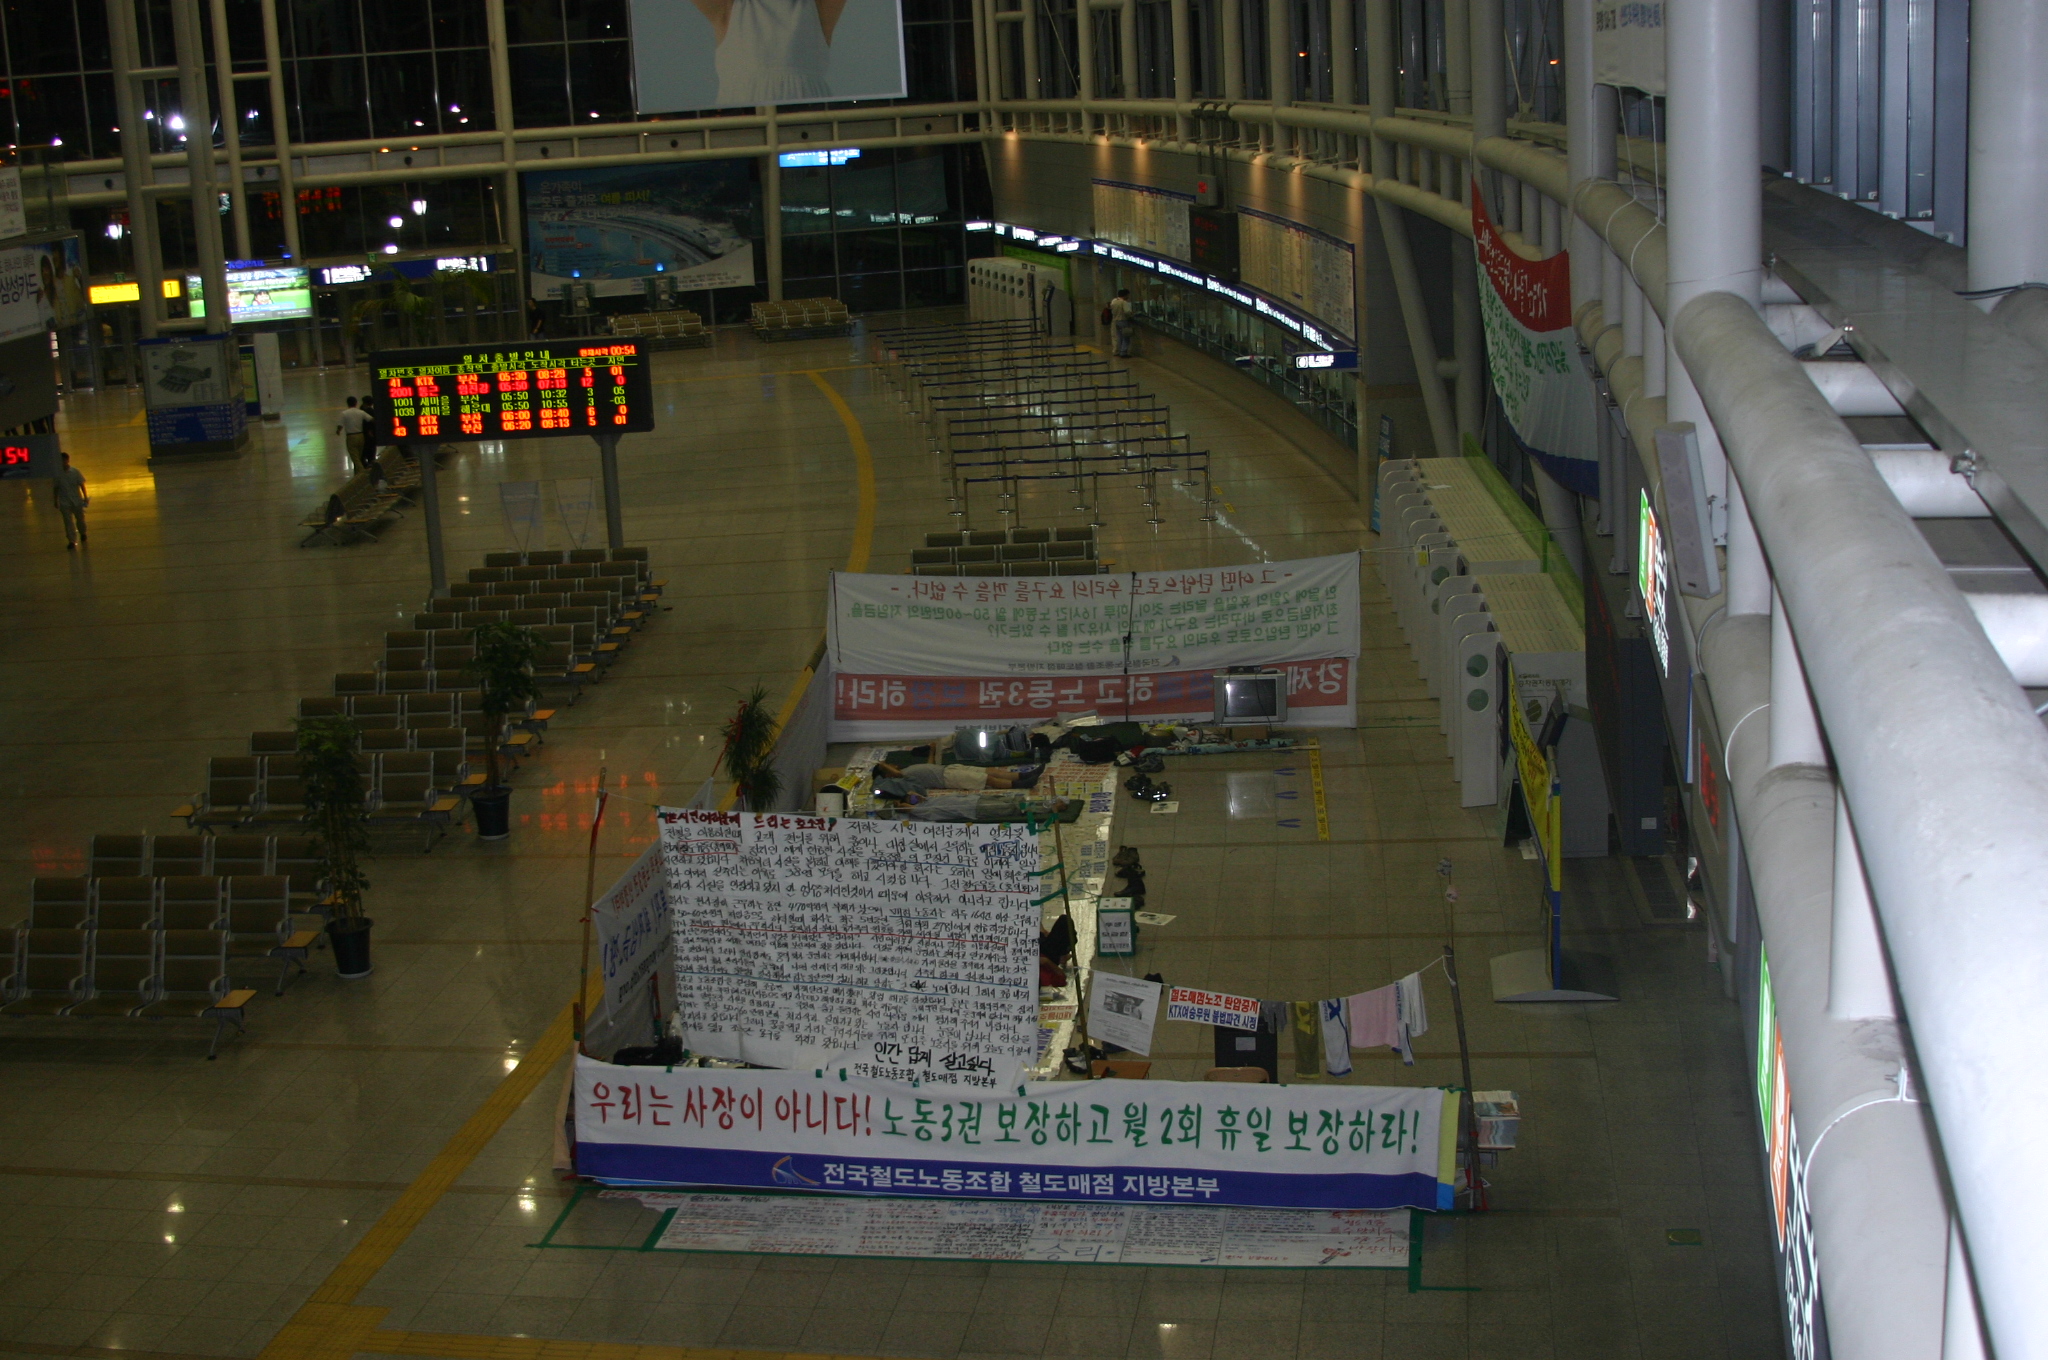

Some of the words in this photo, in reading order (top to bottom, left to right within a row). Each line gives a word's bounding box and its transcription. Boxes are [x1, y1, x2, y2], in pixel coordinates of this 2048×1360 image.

[610, 345, 636, 355] 00:54
[390, 378, 401, 388] 41
[416, 376, 434, 386] KTX
[457, 374, 478, 384] 부산
[498, 371, 527, 381] 05:30
[537, 369, 566, 379] 08:29
[584, 368, 592, 376] 5
[611, 366, 623, 376] 01
[390, 388, 413, 397] 2001
[499, 381, 528, 391] 05:50
[538, 379, 567, 389] 07:13
[581, 378, 593, 386] 12
[616, 376, 625, 385] 0
[393, 398, 413, 406] 1001
[420, 395, 450, 406] 새마을
[460, 394, 480, 404] 부산
[501, 391, 528, 401] 05:50
[541, 389, 567, 399] 10:32
[587, 388, 594, 396] 3
[613, 387, 625, 395] 05
[394, 408, 415, 417] 1039
[421, 405, 451, 416] 새마을
[460, 404, 491, 414] 해운대
[502, 401, 529, 410] 05:50
[541, 399, 568, 408] 10:55
[587, 398, 594, 406] 3
[609, 396, 626, 405] -03
[393, 417, 400, 427] 1
[419, 416, 438, 425] KTX
[461, 413, 481, 424] 부산
[502, 411, 530, 421] 06:00
[541, 409, 570, 419] 08:40
[587, 407, 595, 416] 6
[619, 405, 627, 415] 0
[393, 427, 406, 437] 43
[420, 425, 438, 435] KTX
[462, 423, 482, 434] 부산
[503, 421, 532, 430] 06:20
[541, 419, 570, 428] 09:13
[588, 417, 596, 426] 5
[615, 415, 627, 425] 01
[1170, 989, 1222, 1007] 철도매점노조
[1224, 996, 1258, 1014] 탄압중지
[1168, 1004, 1210, 1022] KTX여승무원
[1212, 1010, 1241, 1026] 불법파견
[1242, 1016, 1256, 1030] 시정
[874, 1041, 903, 1065] 인간
[908, 1045, 932, 1068] 답게
[922, 1070, 958, 1085] 철도매점
[963, 1074, 997, 1089] 지방본부
[590, 1082, 673, 1126] 우리는
[683, 1085, 763, 1131] 사장이
[775, 1089, 872, 1137] 아니다!
[882, 1097, 982, 1145] 노동3권
[994, 1100, 1113, 1146] 보장하고
[1123, 1101, 1148, 1148] 월
[1160, 1102, 1202, 1149] 2회
[1214, 1105, 1272, 1152] 휴일
[1284, 1108, 1419, 1155] 보장하라!
[823, 1162, 1012, 1193] 전국철도노동조합
[1018, 1171, 1114, 1195] 철도매점
[1122, 1175, 1220, 1198] 지방본부
[1036, 1243, 1104, 1262] 승리
